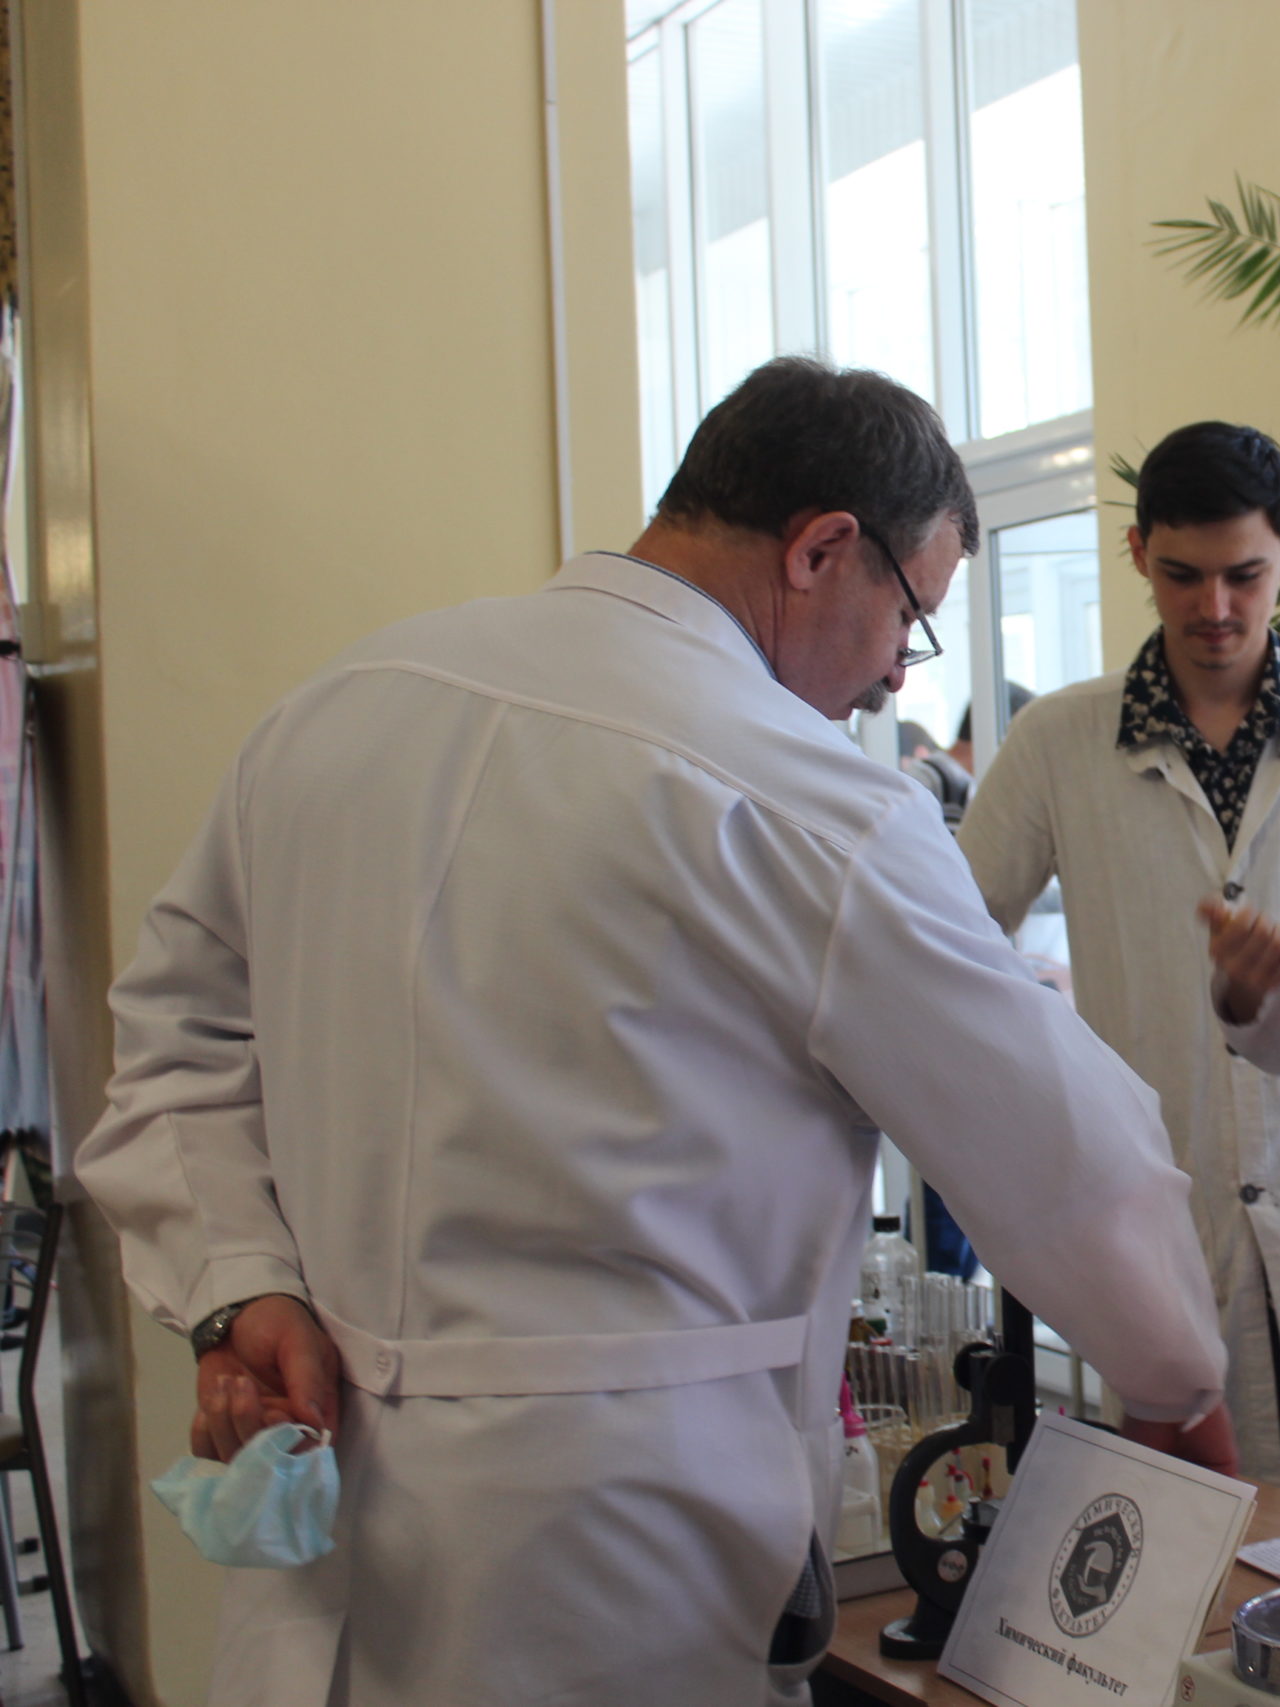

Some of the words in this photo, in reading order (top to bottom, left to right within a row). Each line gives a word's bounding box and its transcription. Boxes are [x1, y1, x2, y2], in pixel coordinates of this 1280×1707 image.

[1051, 1587, 1108, 1633] ФАКУЛЬТЕТ
[994, 1616, 1067, 1667] Химический
[1066, 1652, 1129, 1697] факультет
